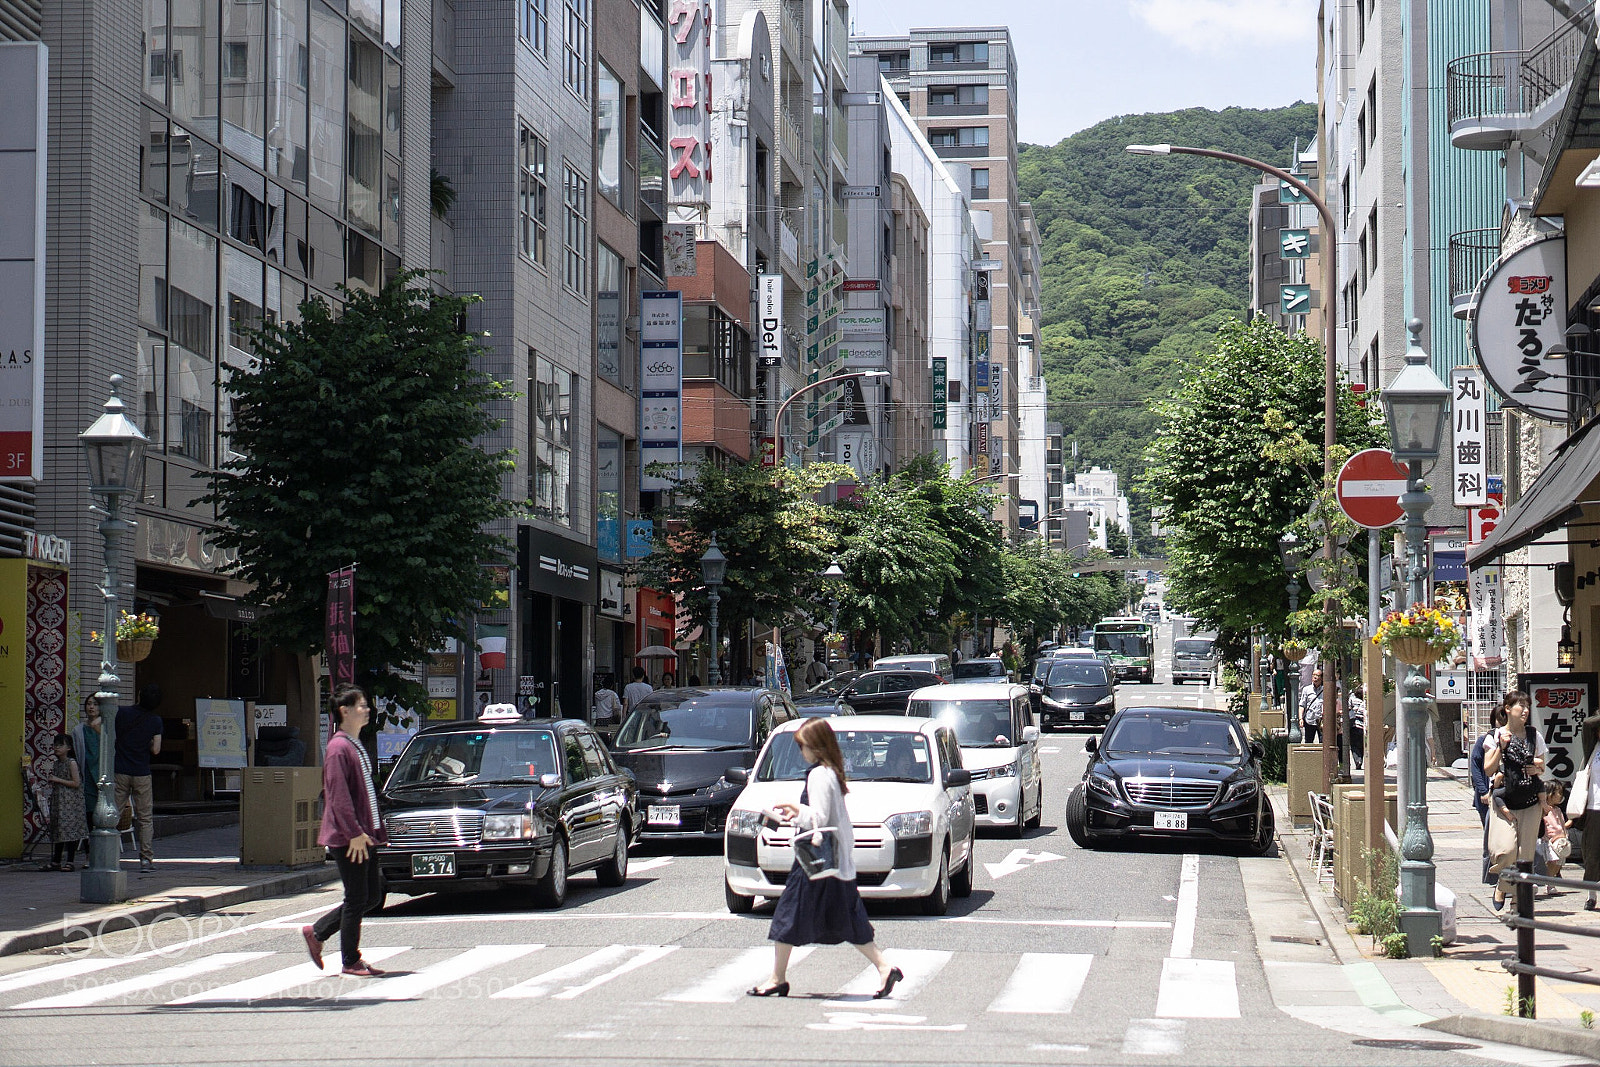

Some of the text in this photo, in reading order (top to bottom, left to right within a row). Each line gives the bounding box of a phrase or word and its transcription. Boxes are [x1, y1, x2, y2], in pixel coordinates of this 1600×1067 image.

[1520, 279, 1546, 292] ラーメン
[1541, 294, 1554, 320] 神戸
[762, 318, 778, 351] Def
[1457, 376, 1482, 498] 丸川歯科
[7, 453, 25, 469] 3F
[24, 531, 70, 564] TAKAZEN
[1548, 692, 1577, 705] ラーメン
